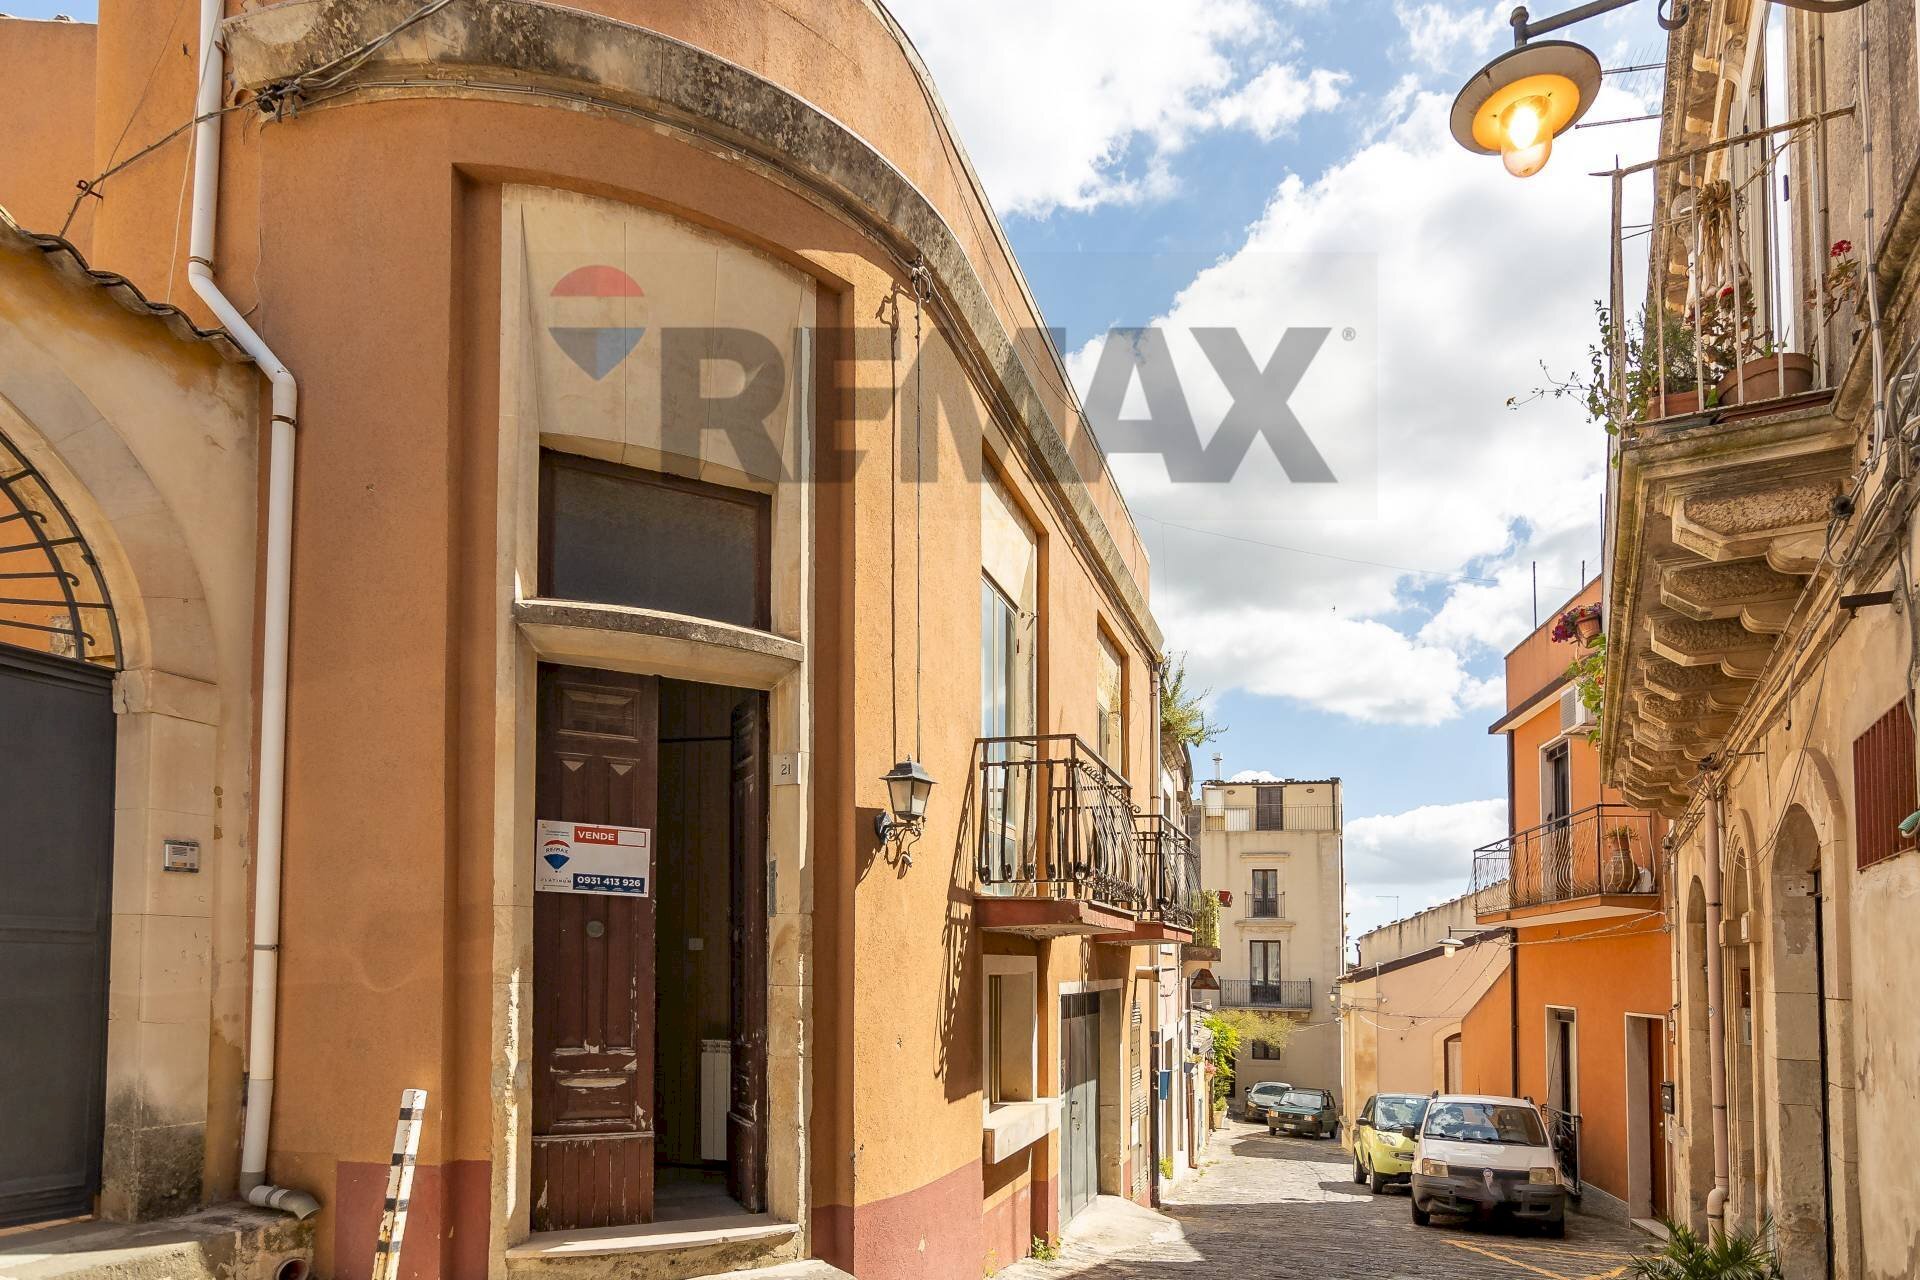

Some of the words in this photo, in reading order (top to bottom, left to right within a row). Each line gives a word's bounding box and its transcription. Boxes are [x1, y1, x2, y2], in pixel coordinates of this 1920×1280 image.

[781, 764, 791, 776] 21
[578, 830, 615, 841] VENDE
[577, 876, 601, 885] 0931
[603, 877, 620, 886] 413
[622, 879, 641, 887] 926
